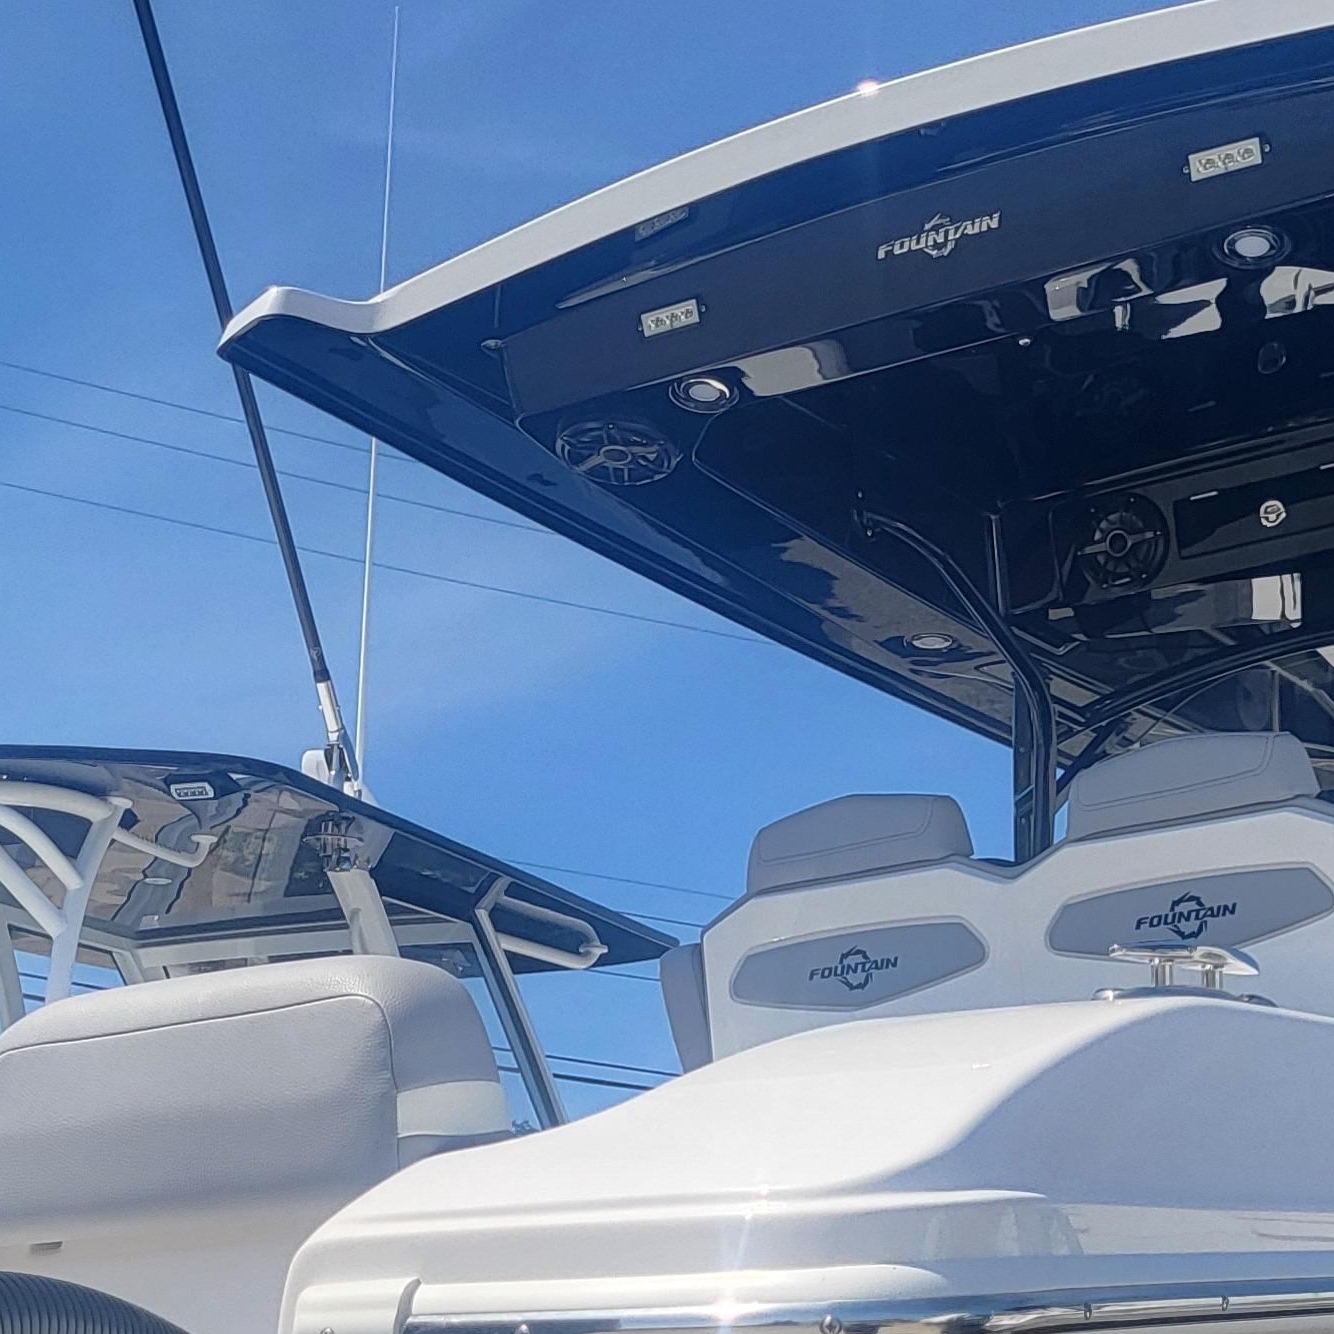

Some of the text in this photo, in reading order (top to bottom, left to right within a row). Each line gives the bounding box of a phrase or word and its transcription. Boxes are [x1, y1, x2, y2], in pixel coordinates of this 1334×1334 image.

[877, 210, 1001, 260] FOUNTAIN
[1134, 902, 1237, 931] FOUNTAIN
[809, 956, 898, 981] FOUNTAIN
